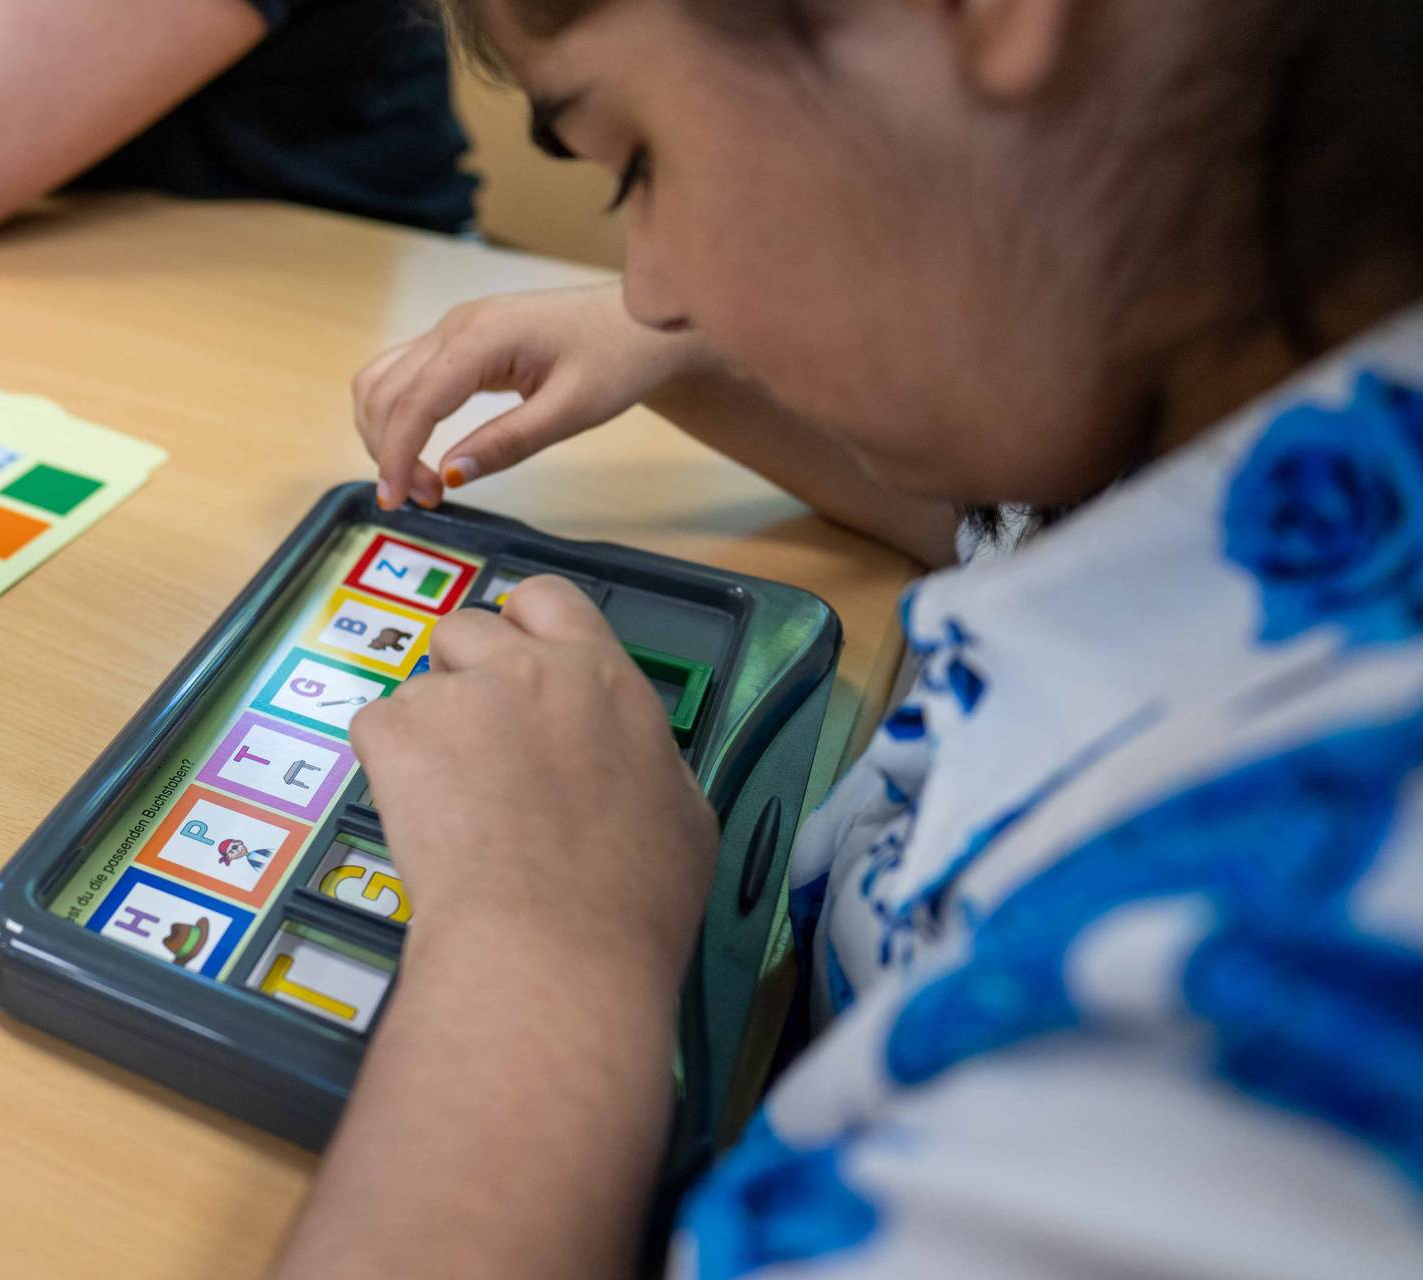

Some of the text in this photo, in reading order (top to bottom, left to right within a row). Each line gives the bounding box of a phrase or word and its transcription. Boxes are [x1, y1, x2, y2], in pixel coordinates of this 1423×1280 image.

[375, 559, 409, 579] Z
[334, 616, 368, 636] B
[289, 677, 327, 699] G
[233, 745, 271, 766] T
[77, 891, 94, 907] du
[89, 874, 108, 892] die
[103, 817, 150, 876] passenden
[142, 758, 194, 819] Buchstaben?
[180, 819, 216, 847] P
[318, 865, 415, 925] G
[114, 906, 161, 938] H
[259, 953, 357, 1022] T
